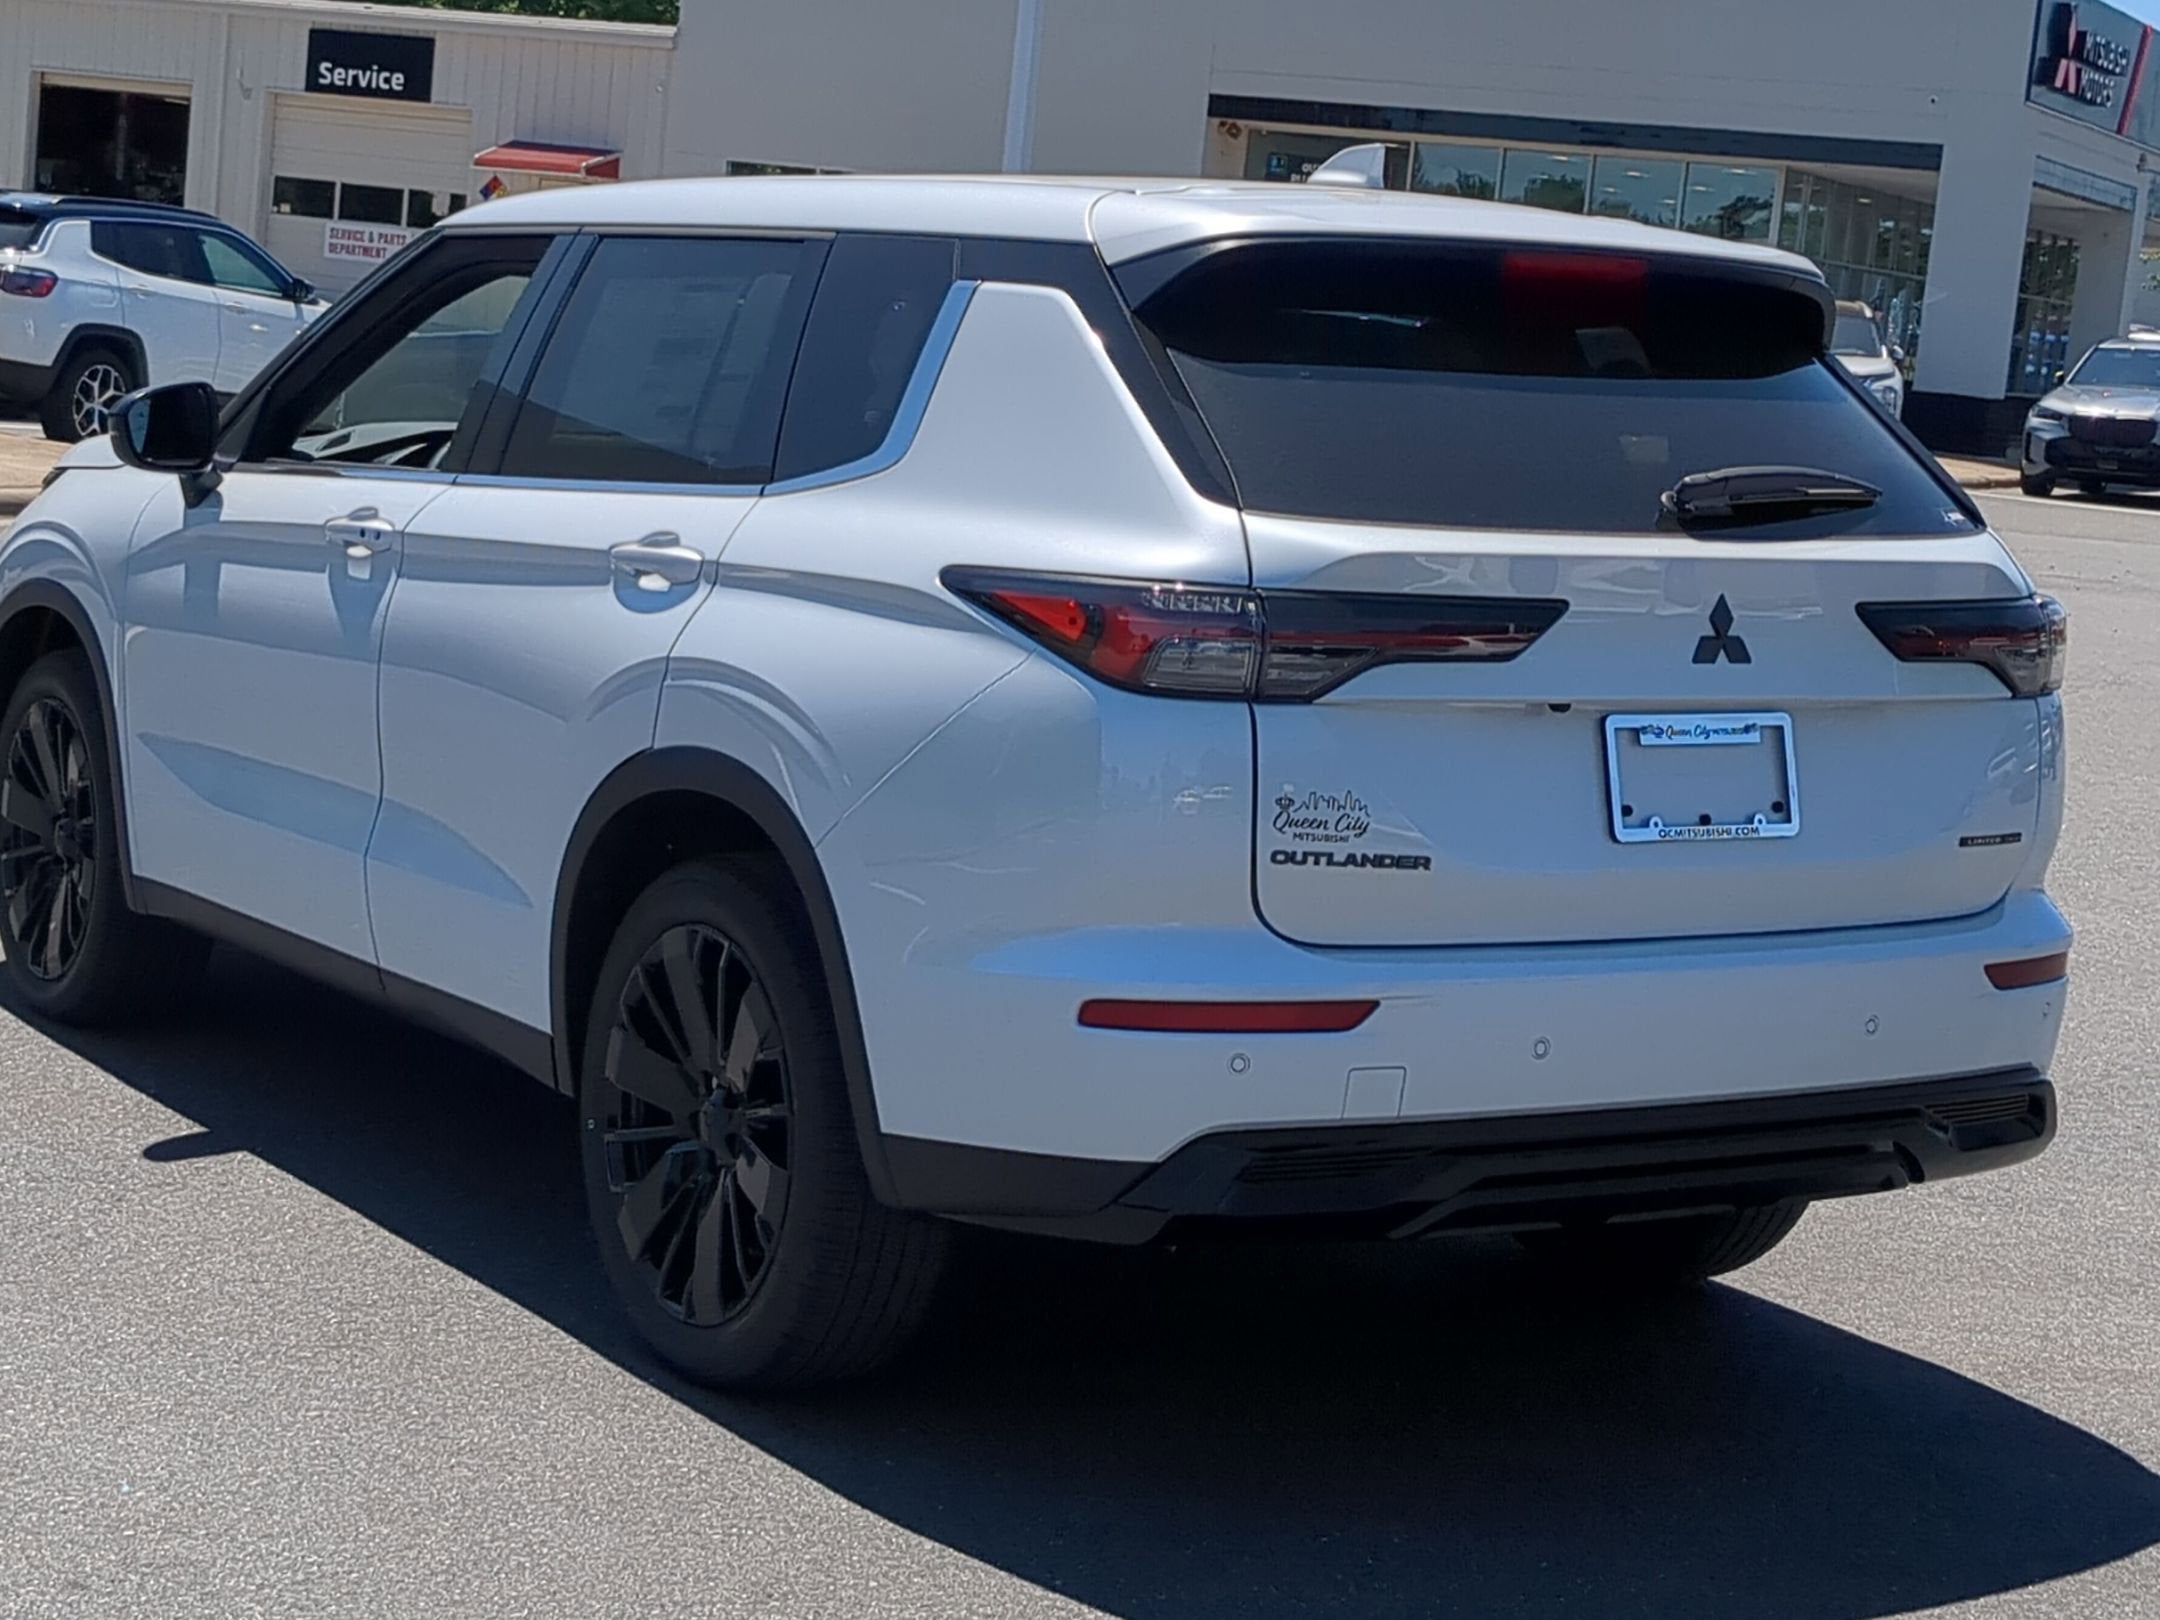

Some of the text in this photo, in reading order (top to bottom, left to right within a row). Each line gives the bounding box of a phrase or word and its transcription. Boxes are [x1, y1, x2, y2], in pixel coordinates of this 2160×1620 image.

[318, 61, 405, 91] Service
[2079, 68, 2115, 108] MOTORS
[329, 227, 366, 243] SERVICE
[378, 232, 407, 247] PARTS
[328, 241, 387, 259] DEPARTMENT
[1273, 809, 1371, 839] Queen City
[1292, 831, 1350, 844] MITSUBISHI
[1270, 849, 1433, 872] OUTLANDER
